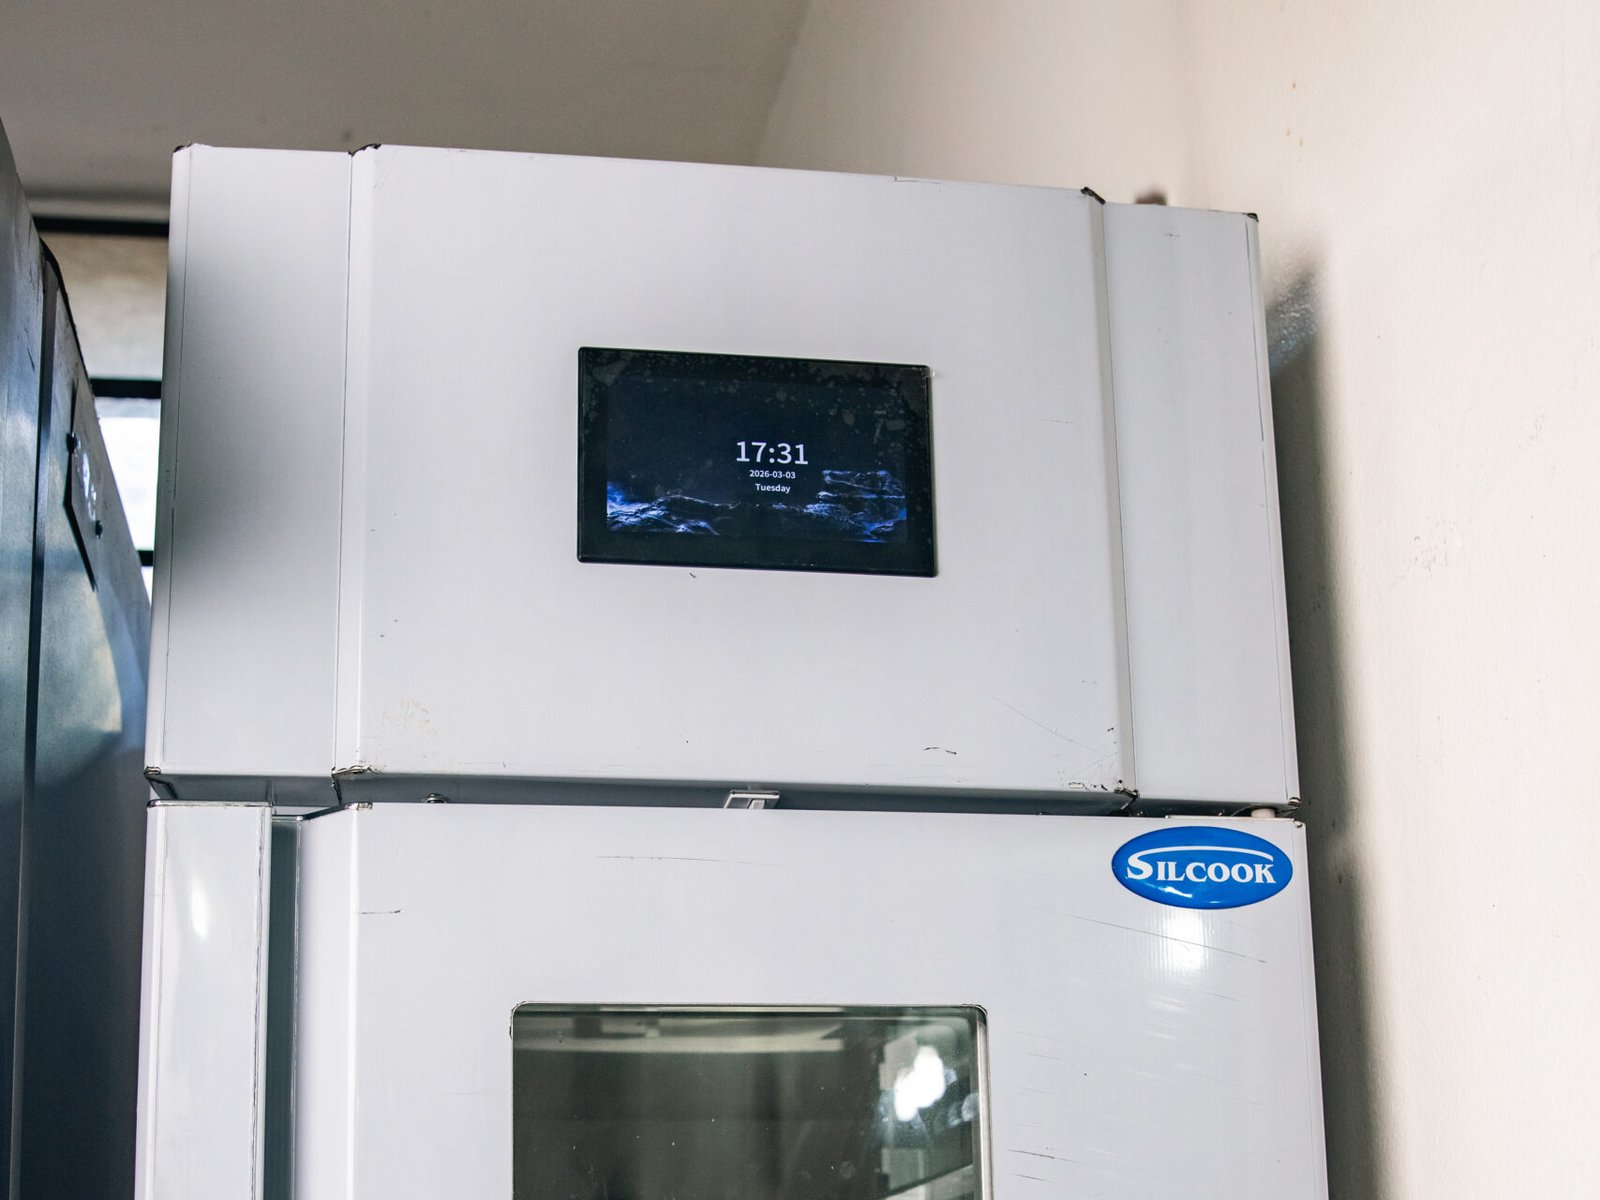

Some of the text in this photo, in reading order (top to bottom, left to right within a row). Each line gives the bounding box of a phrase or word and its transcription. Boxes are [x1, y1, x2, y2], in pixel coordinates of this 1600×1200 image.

[736, 441, 808, 465] 17:31
[749, 469, 796, 479] 2026-03-03
[755, 483, 791, 494] Tuesday
[1126, 845, 1277, 884] SILCOOK
